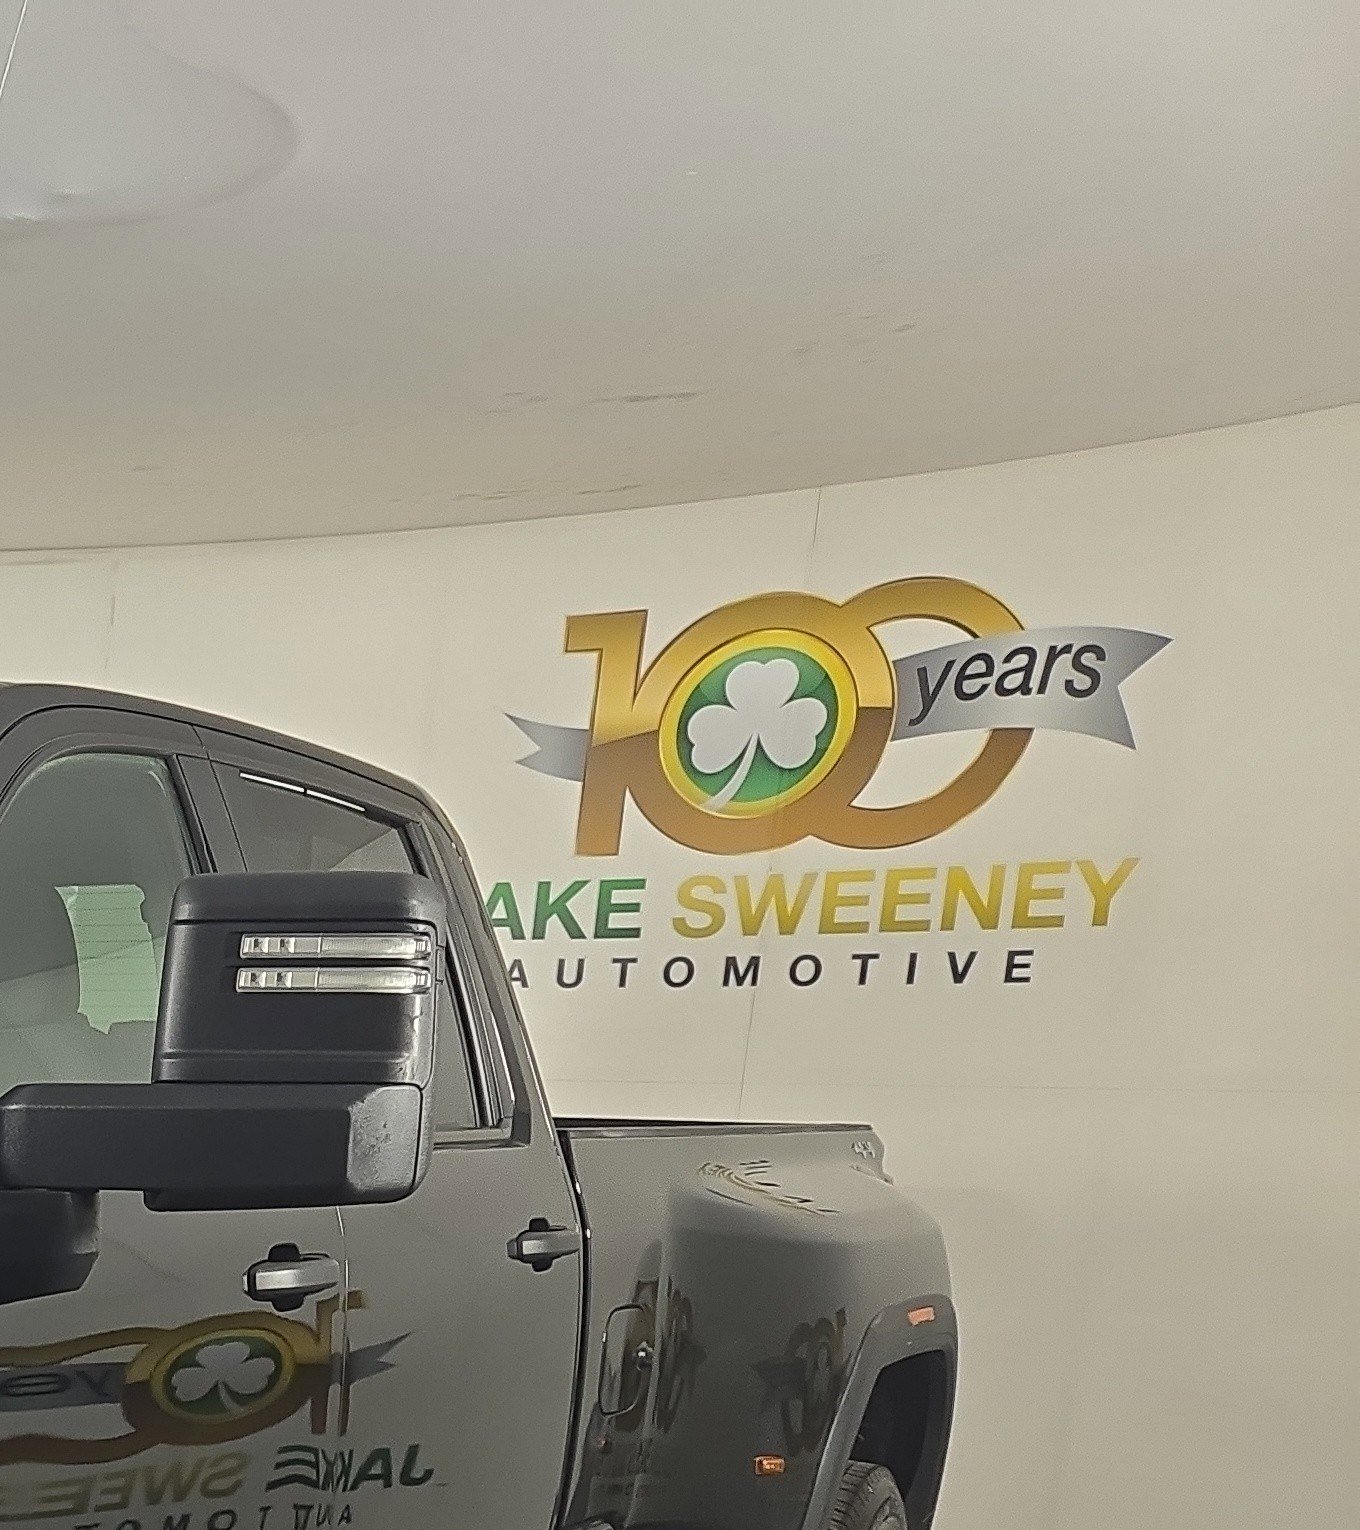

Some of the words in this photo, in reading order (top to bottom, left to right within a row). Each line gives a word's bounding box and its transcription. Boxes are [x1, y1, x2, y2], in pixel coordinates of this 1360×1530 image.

[564, 576, 1037, 856] 100
[907, 640, 1107, 727] years
[485, 878, 646, 940] AKE
[671, 857, 1141, 938] SWEENEY
[508, 949, 1035, 990] AUTOMOTIVE
